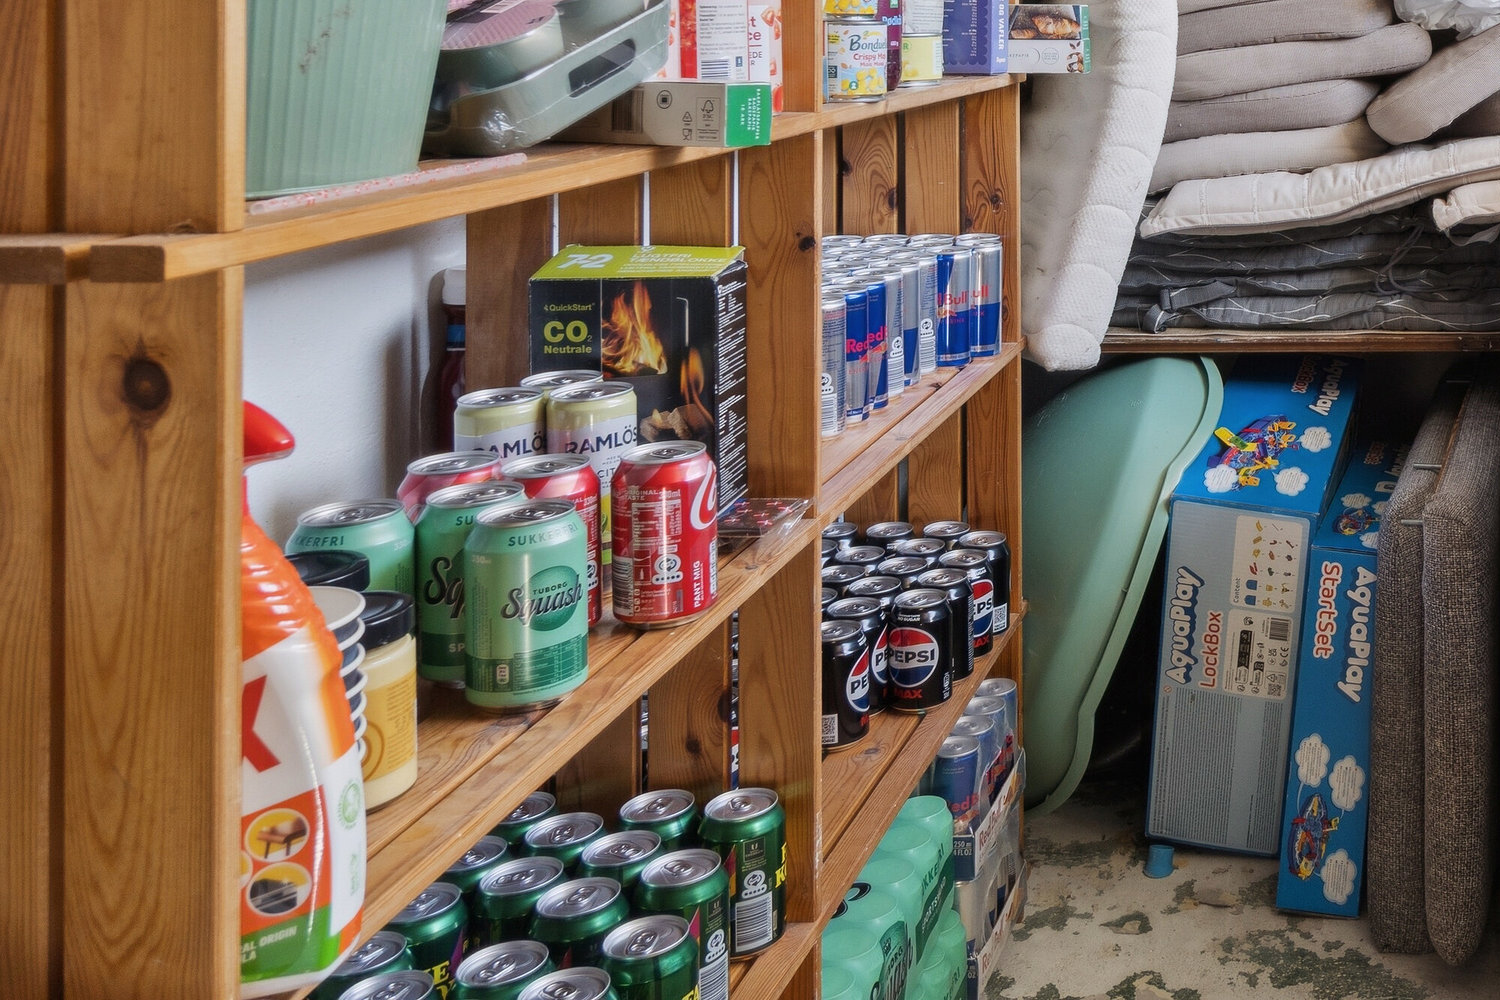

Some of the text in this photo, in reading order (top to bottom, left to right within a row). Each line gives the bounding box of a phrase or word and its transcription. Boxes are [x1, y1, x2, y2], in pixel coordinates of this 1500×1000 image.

[998, 3, 1006, 16] OG
[998, 18, 1006, 50] VAFLER
[557, 254, 614, 269] 72
[550, 303, 593, 312] QuickStart
[543, 345, 593, 354] Neutrale
[296, 536, 345, 547] KERFRI
[508, 522, 578, 547] SUKKERFRI
[533, 581, 568, 596] TUBORG
[693, 560, 702, 608] PANT MIG
[1233, 577, 1241, 603] Content
[500, 574, 584, 627] Squash
[1313, 561, 1343, 660] StartSet
[1165, 565, 1206, 686] AquaPlay
[1337, 566, 1378, 703] AquaPlay
[890, 647, 935, 664] PEPSI
[1199, 611, 1222, 689] LockBox
[953, 840, 966, 848] 250
[260, 926, 297, 948] ORIGIN
